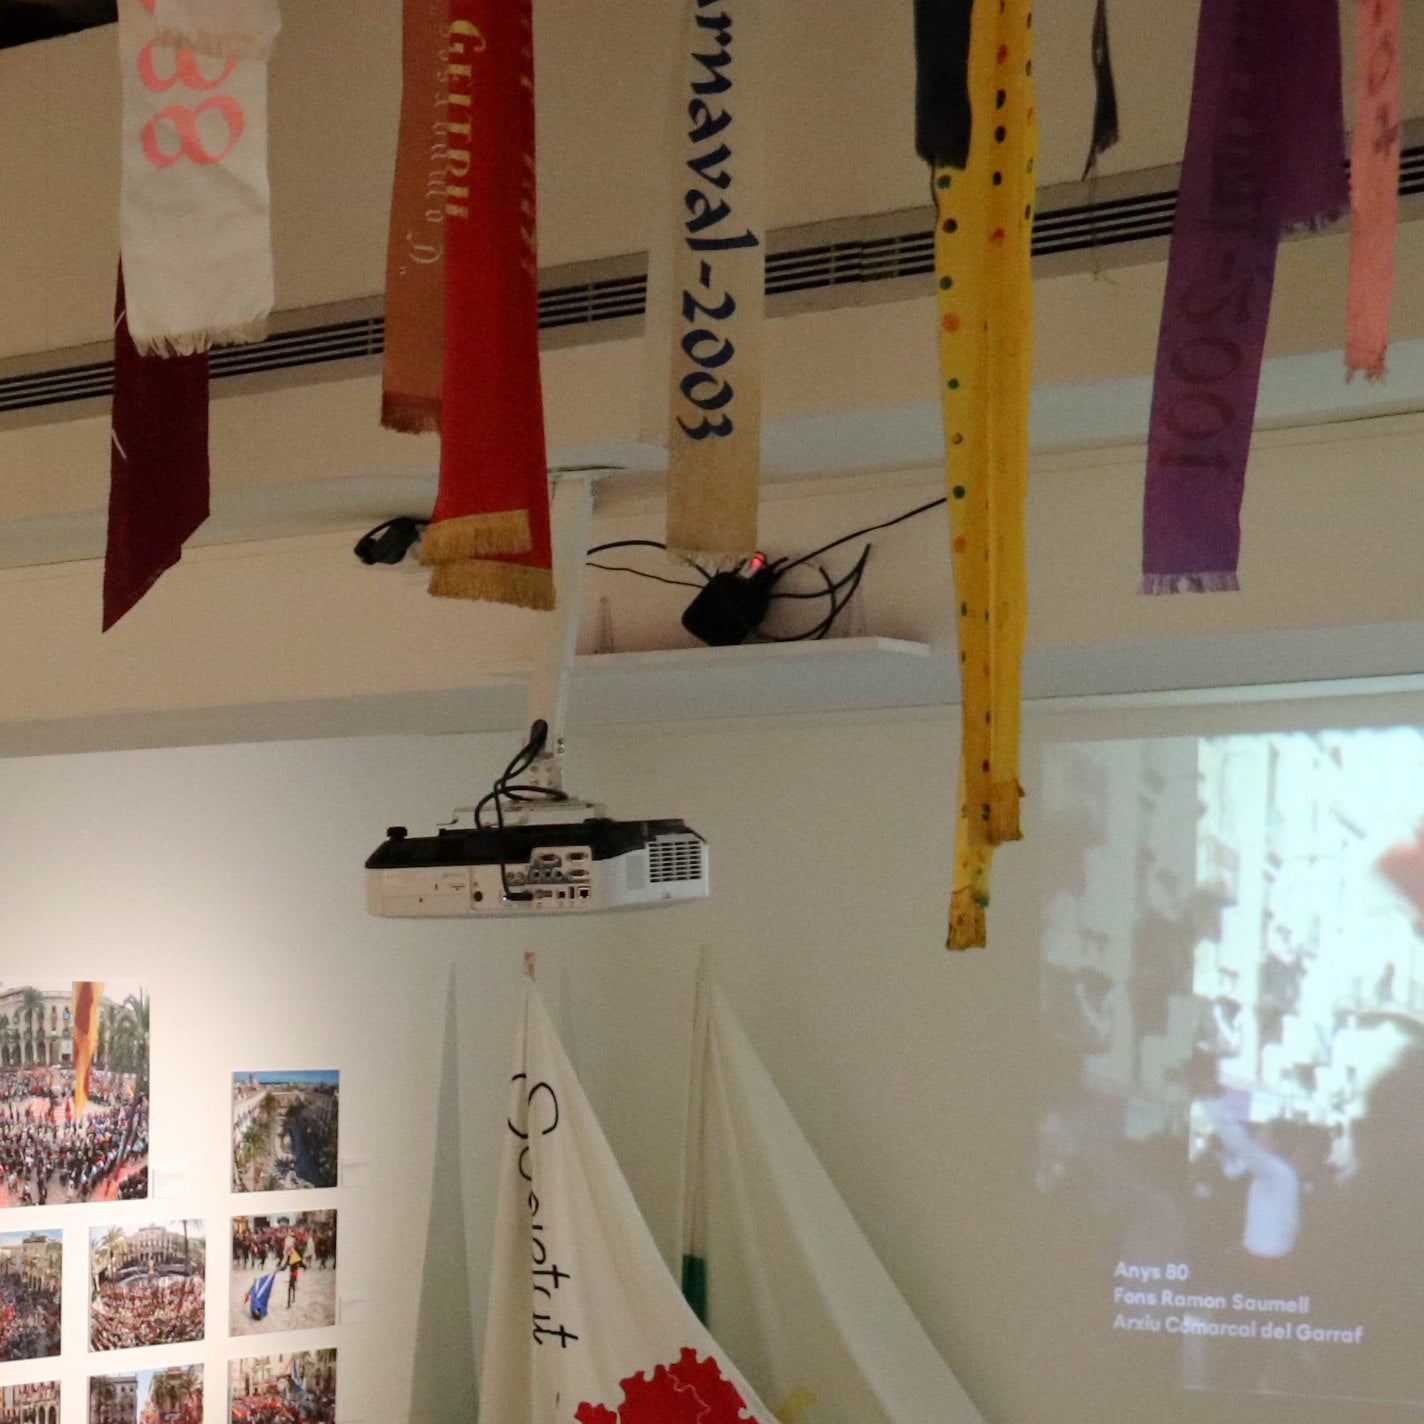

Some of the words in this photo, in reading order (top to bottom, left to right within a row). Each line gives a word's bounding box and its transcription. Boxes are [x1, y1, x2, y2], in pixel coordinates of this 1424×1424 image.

[676, 0, 759, 441] rnaval-2003
[1113, 1261, 1161, 1283] Anys
[1165, 1263, 1189, 1282] 80
[1113, 1286, 1157, 1306] Fons
[1161, 1289, 1226, 1309] Ramon
[1231, 1293, 1310, 1315] Saumell
[1113, 1313, 1161, 1332] Arxiu
[1164, 1316, 1256, 1339] Comarcal
[1260, 1321, 1292, 1340] del
[1295, 1324, 1365, 1345] Garraf
